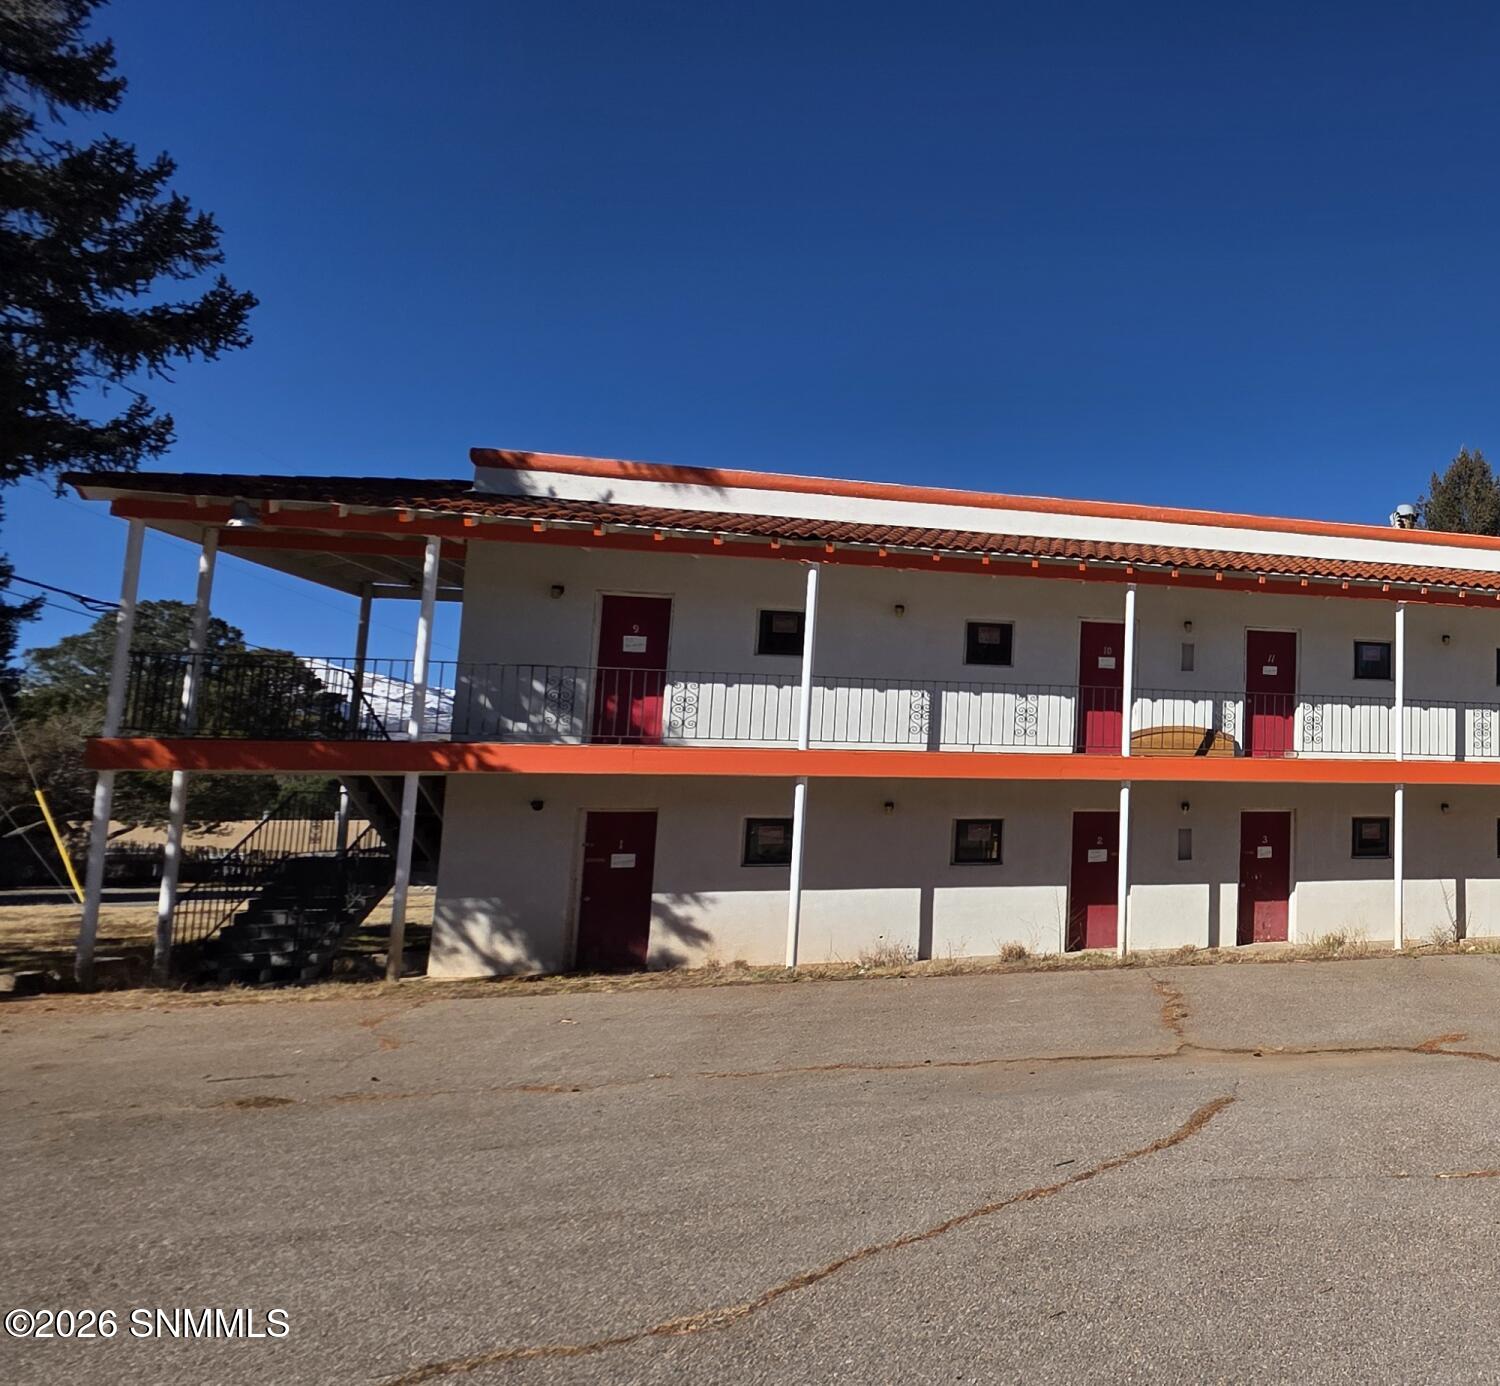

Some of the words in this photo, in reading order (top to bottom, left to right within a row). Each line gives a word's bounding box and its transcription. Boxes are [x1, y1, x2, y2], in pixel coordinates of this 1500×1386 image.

[632, 624, 640, 633] 9
[1103, 646, 1112, 655] 10
[1097, 836, 1104, 845] 2
[1262, 835, 1268, 844] 3
